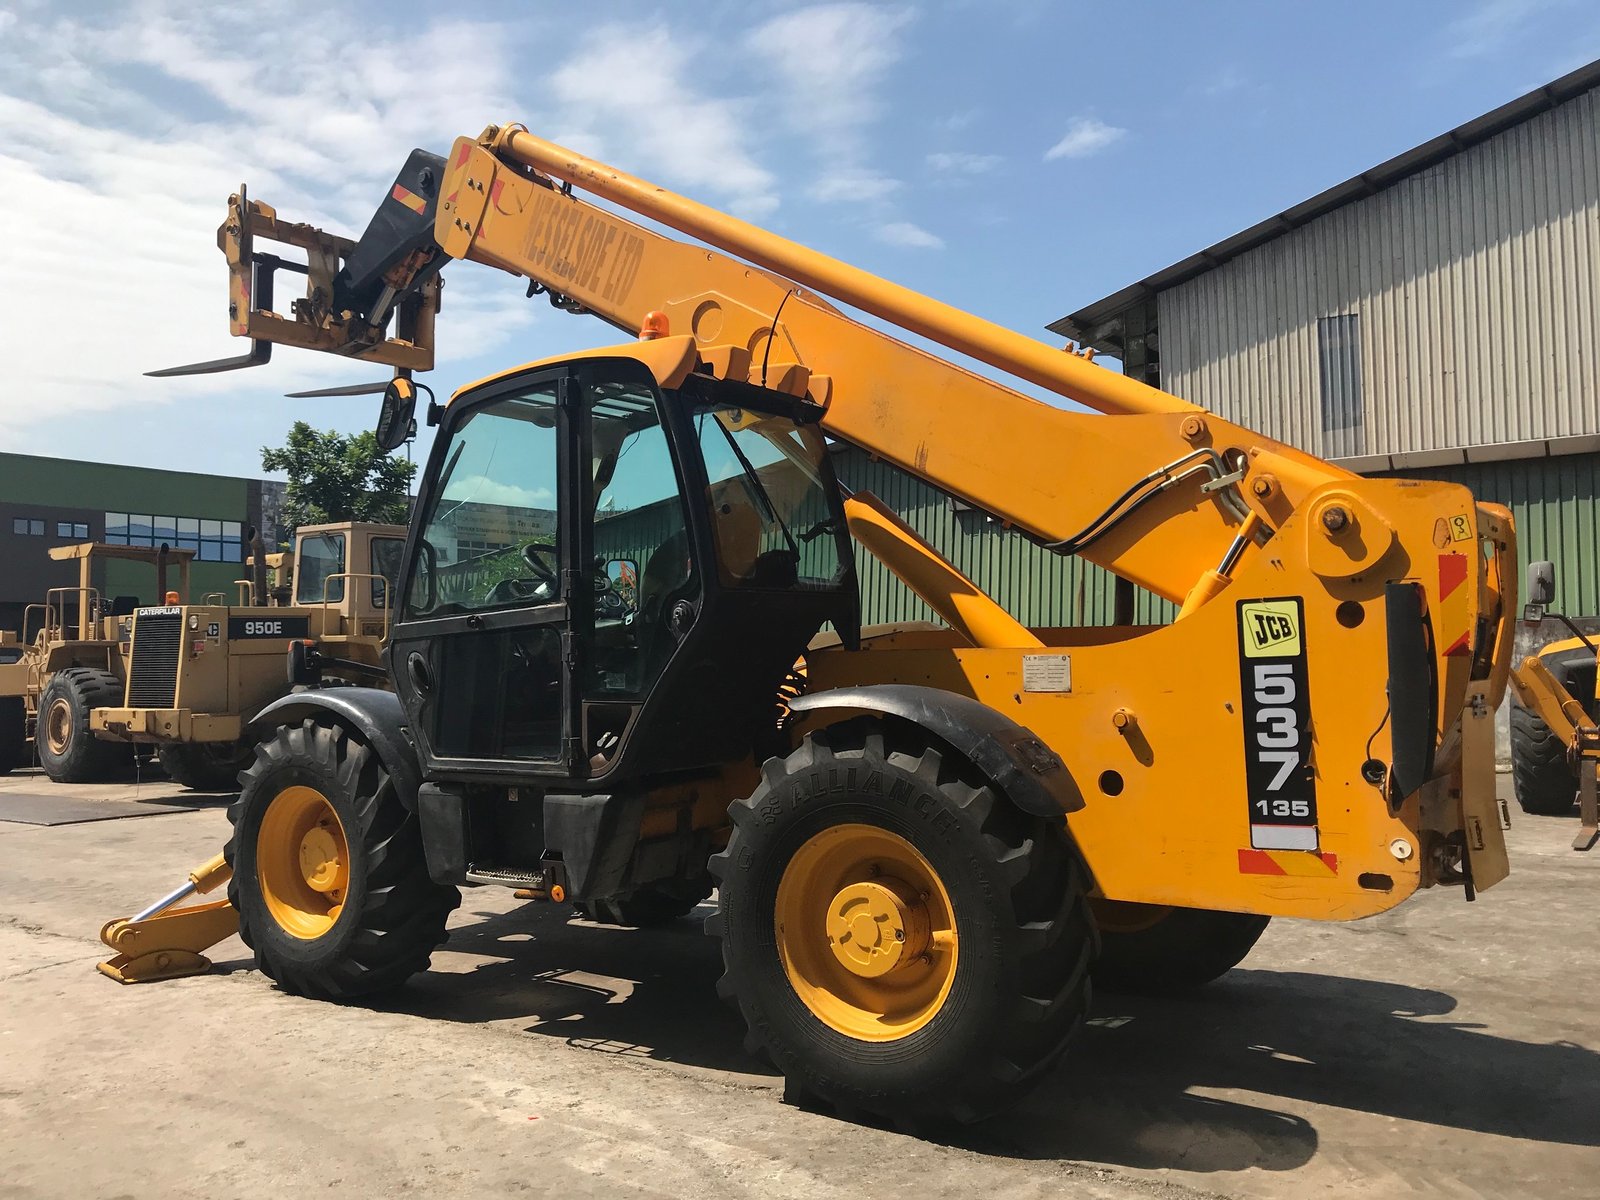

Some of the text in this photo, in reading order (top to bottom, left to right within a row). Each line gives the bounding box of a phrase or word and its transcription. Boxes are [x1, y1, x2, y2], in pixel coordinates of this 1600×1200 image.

[602, 231, 645, 306] LTD
[139, 607, 180, 616] CATERPILLAR
[245, 621, 282, 635] 950E
[1253, 613, 1293, 646] JCB
[1253, 663, 1300, 791] 537
[791, 767, 958, 836] ALLIANCE
[1256, 799, 1310, 817] 135
